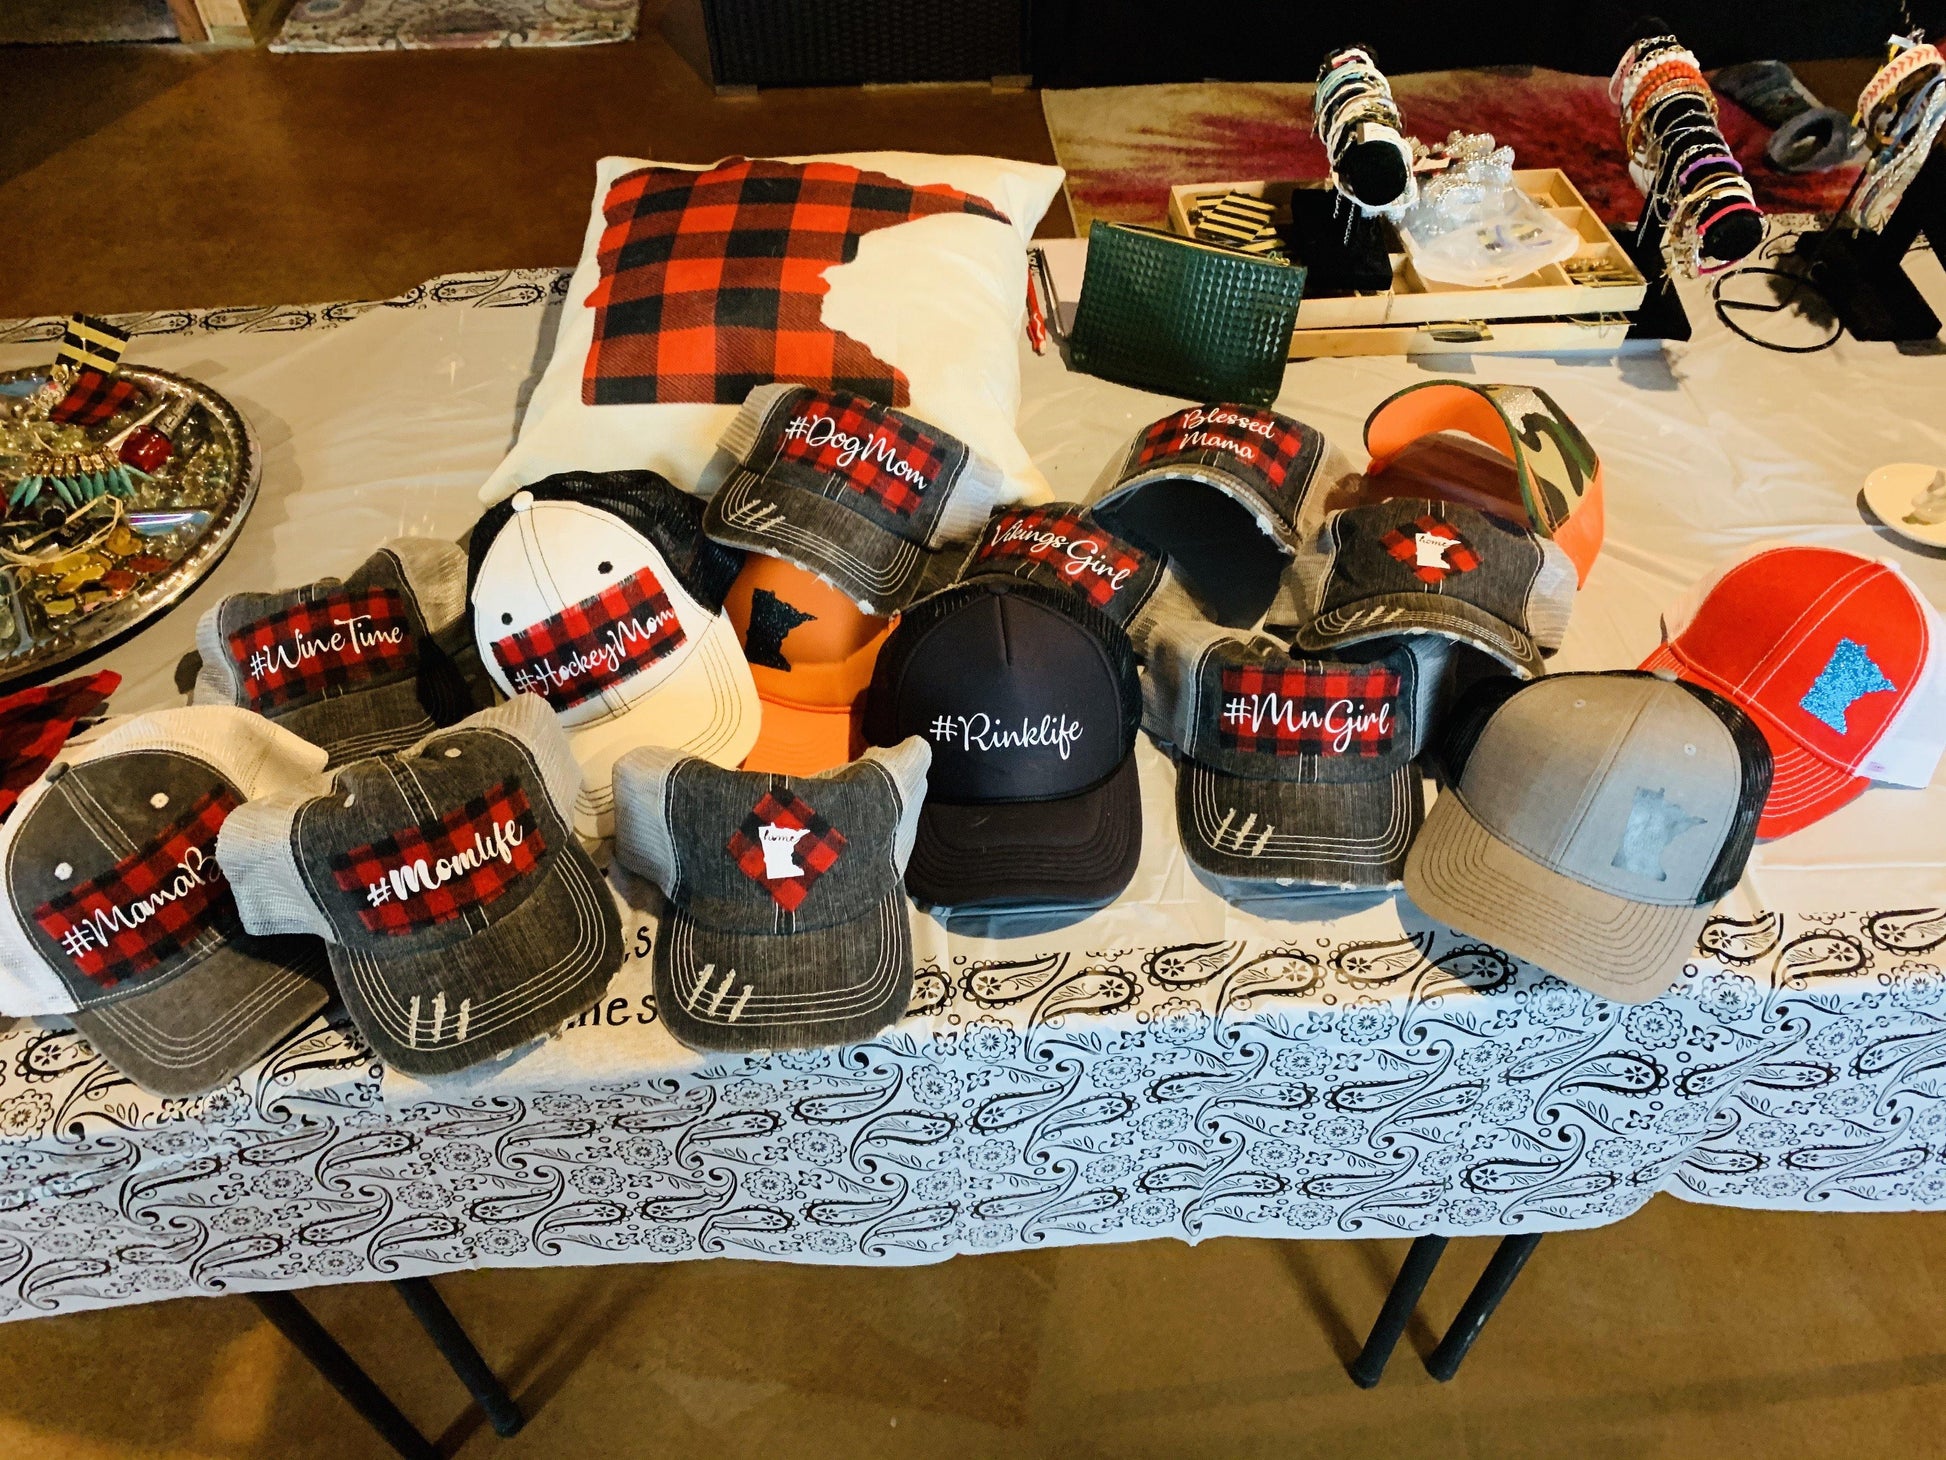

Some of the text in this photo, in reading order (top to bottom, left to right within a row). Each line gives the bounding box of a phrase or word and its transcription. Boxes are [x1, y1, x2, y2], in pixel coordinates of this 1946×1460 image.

[785, 414, 928, 490] #DogMom
[1179, 431, 1255, 459] Mama
[1182, 407, 1275, 439] Blessed
[991, 519, 1131, 590] Vikings Girl
[515, 609, 676, 695] #HockeyMom
[929, 712, 1084, 760] #Rinklife
[366, 819, 523, 907] #Momlife
